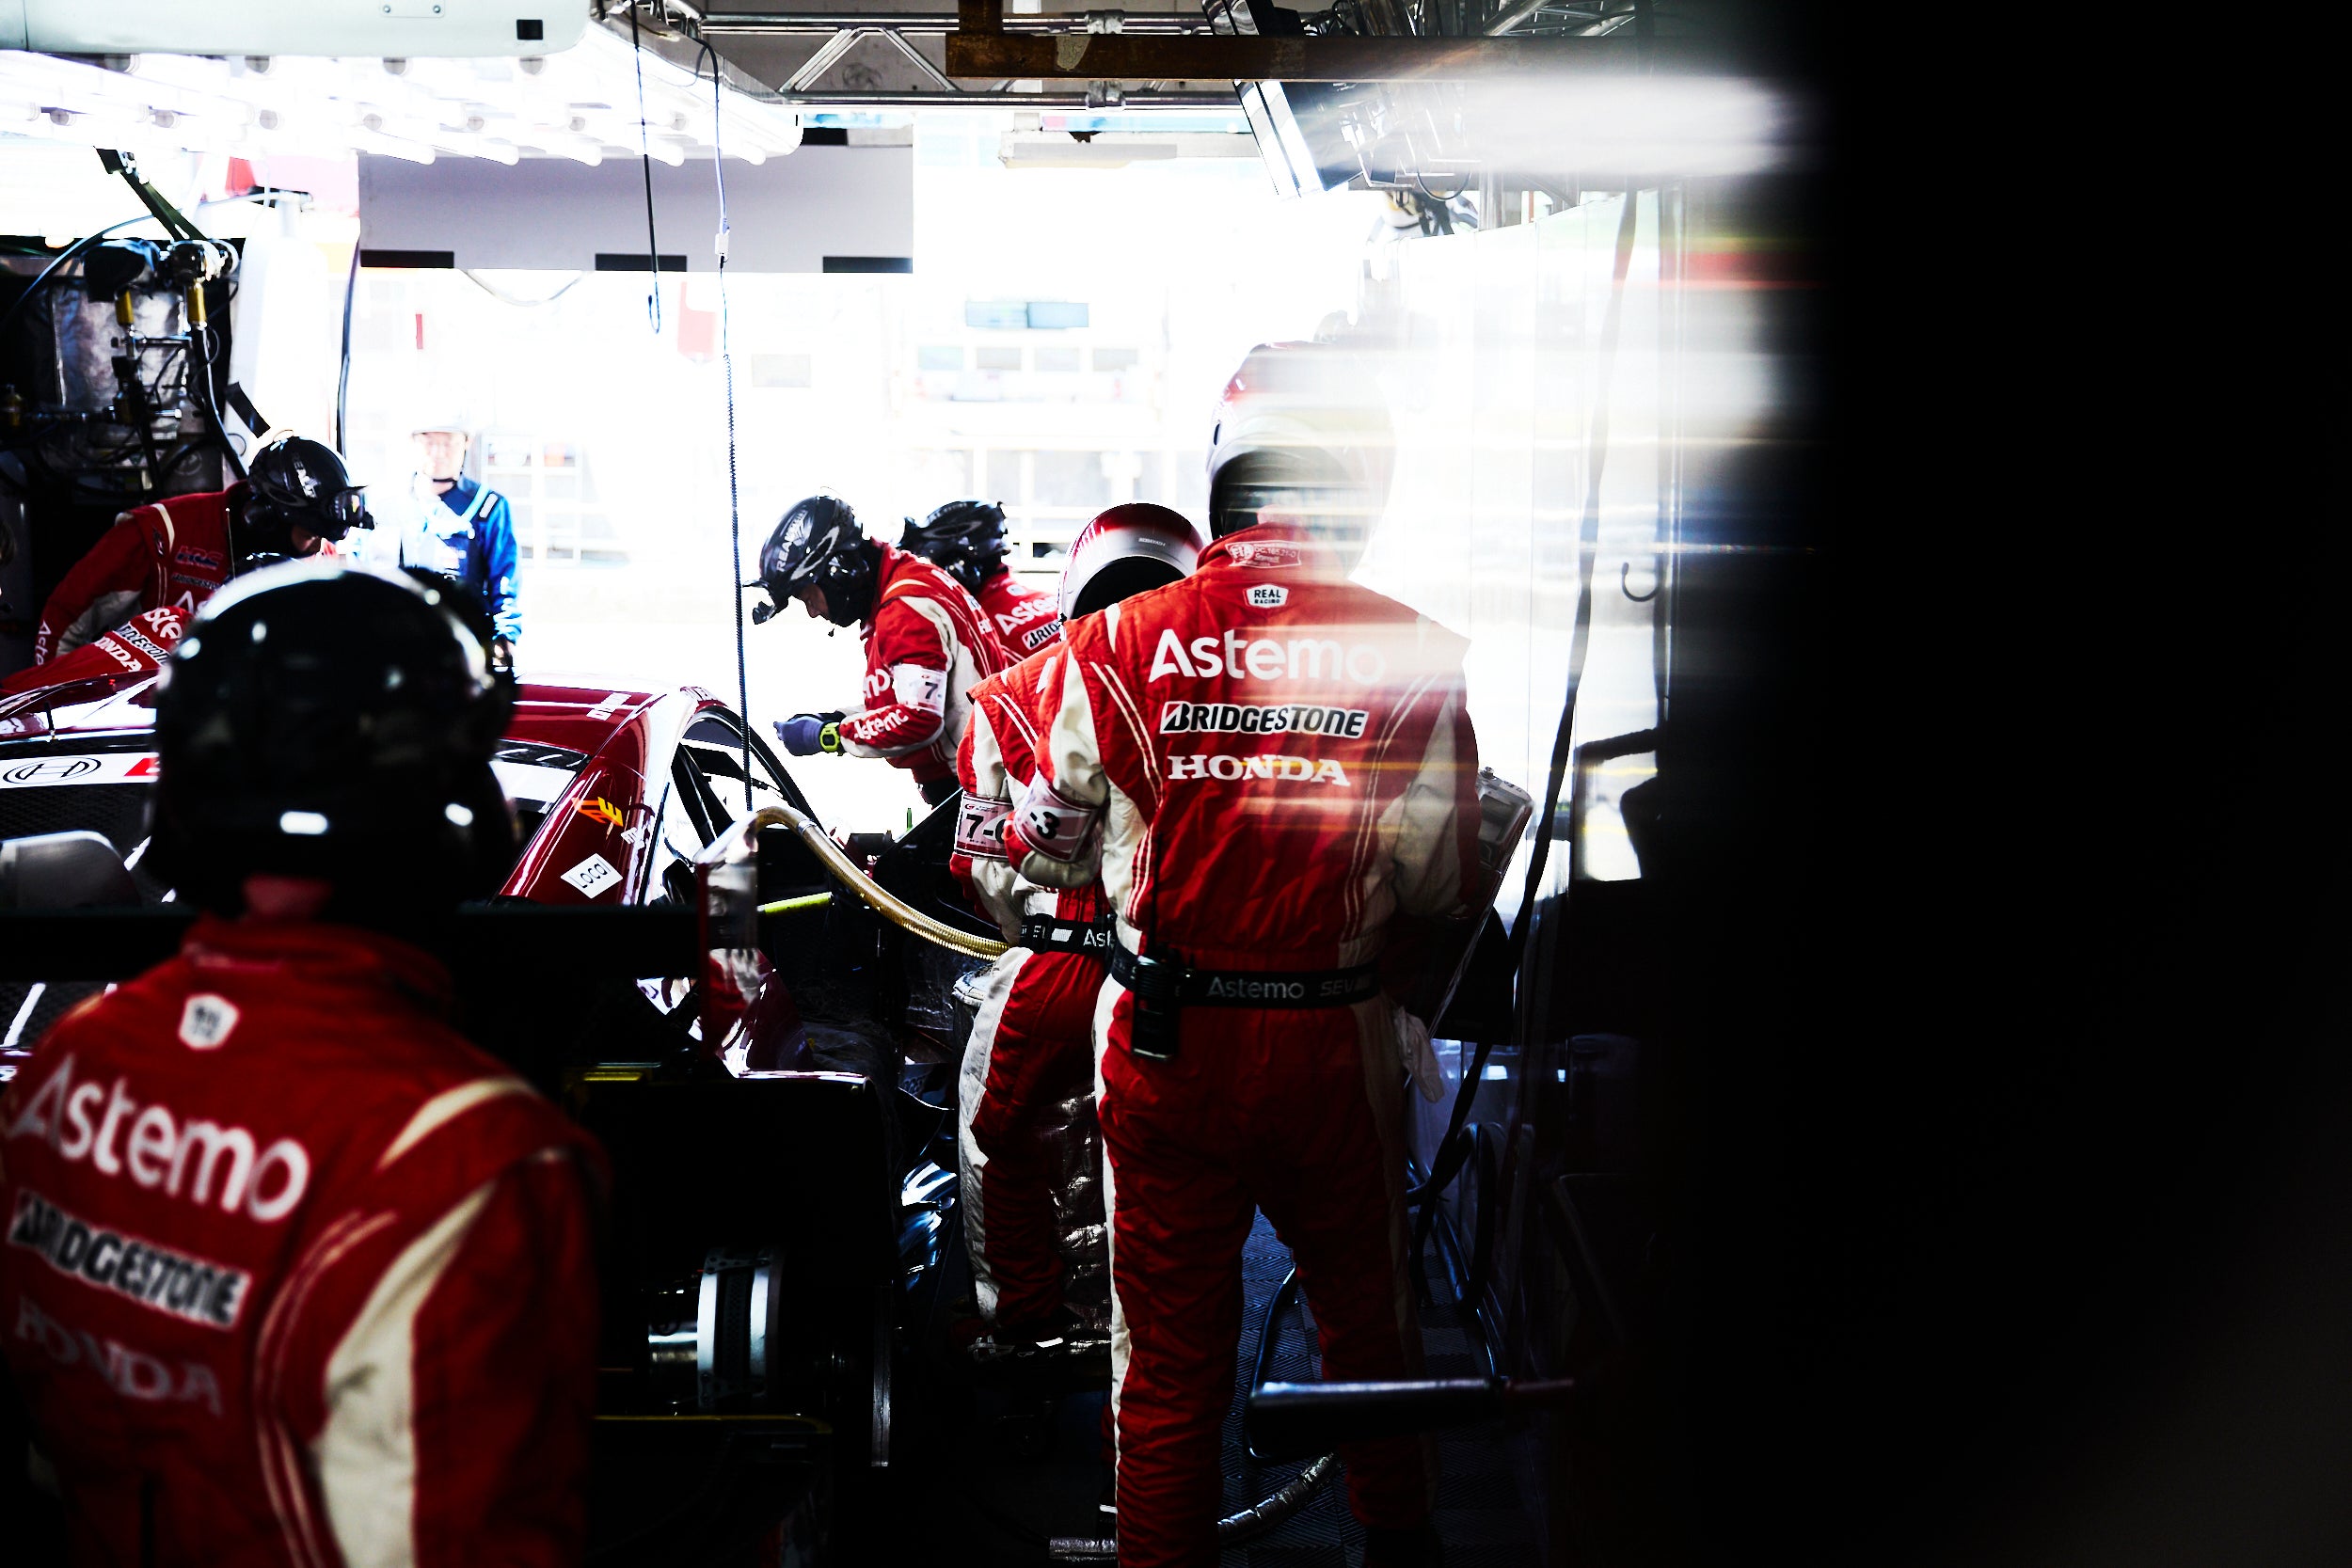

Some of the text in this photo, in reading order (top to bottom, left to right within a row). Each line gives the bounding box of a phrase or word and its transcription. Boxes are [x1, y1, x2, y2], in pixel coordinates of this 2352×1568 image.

[1254, 589, 1281, 598] REAL
[1149, 629, 1385, 685] Astemo
[1163, 704, 1365, 736] BRIDGESTONE
[1168, 754, 1350, 786] HONDA
[1029, 811, 1060, 840] -3
[568, 857, 612, 889] Local
[1206, 976, 1305, 999] Astemo
[4, 1052, 311, 1224] Astemo
